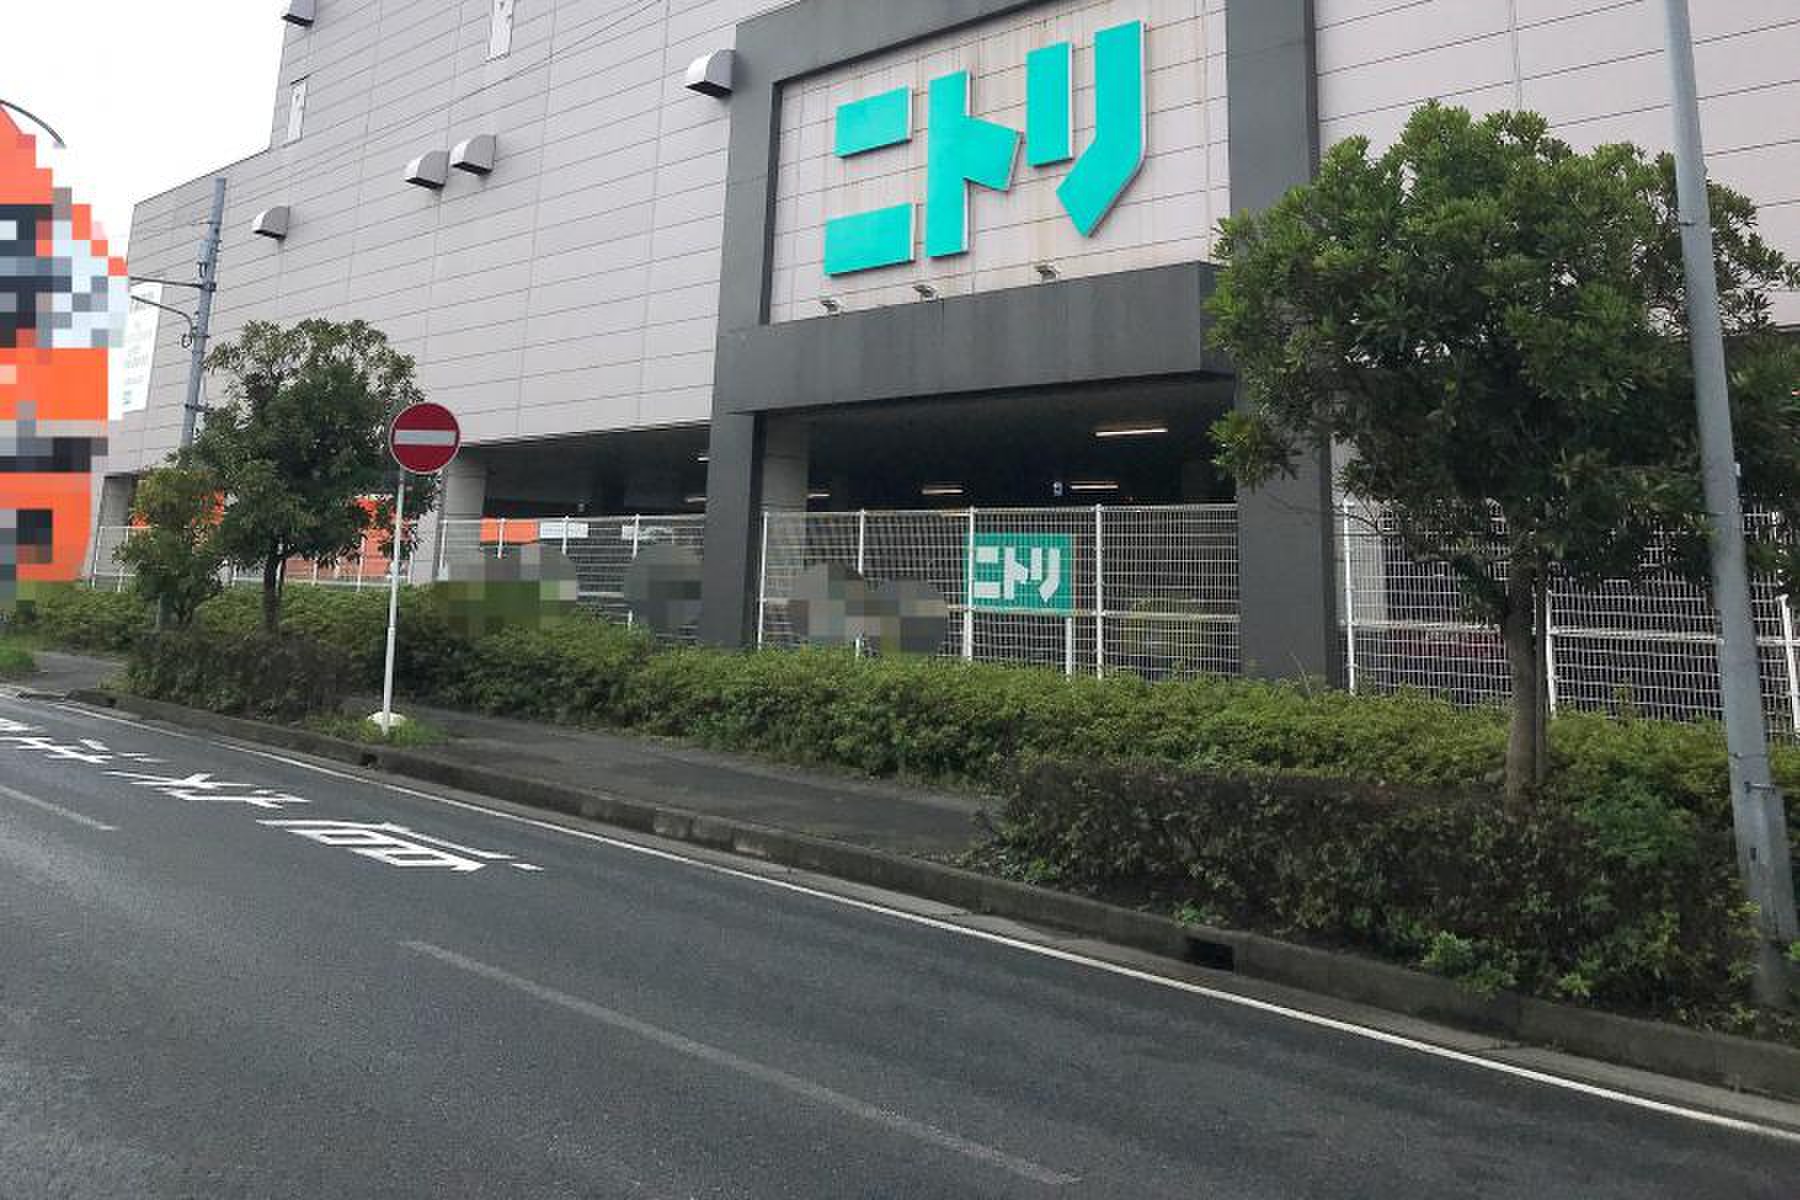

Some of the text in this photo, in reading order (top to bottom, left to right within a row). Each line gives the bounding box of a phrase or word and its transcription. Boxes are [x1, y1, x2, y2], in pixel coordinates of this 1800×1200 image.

[824, 19, 1147, 276] ニトリ
[973, 546, 1061, 602] ニトリ
